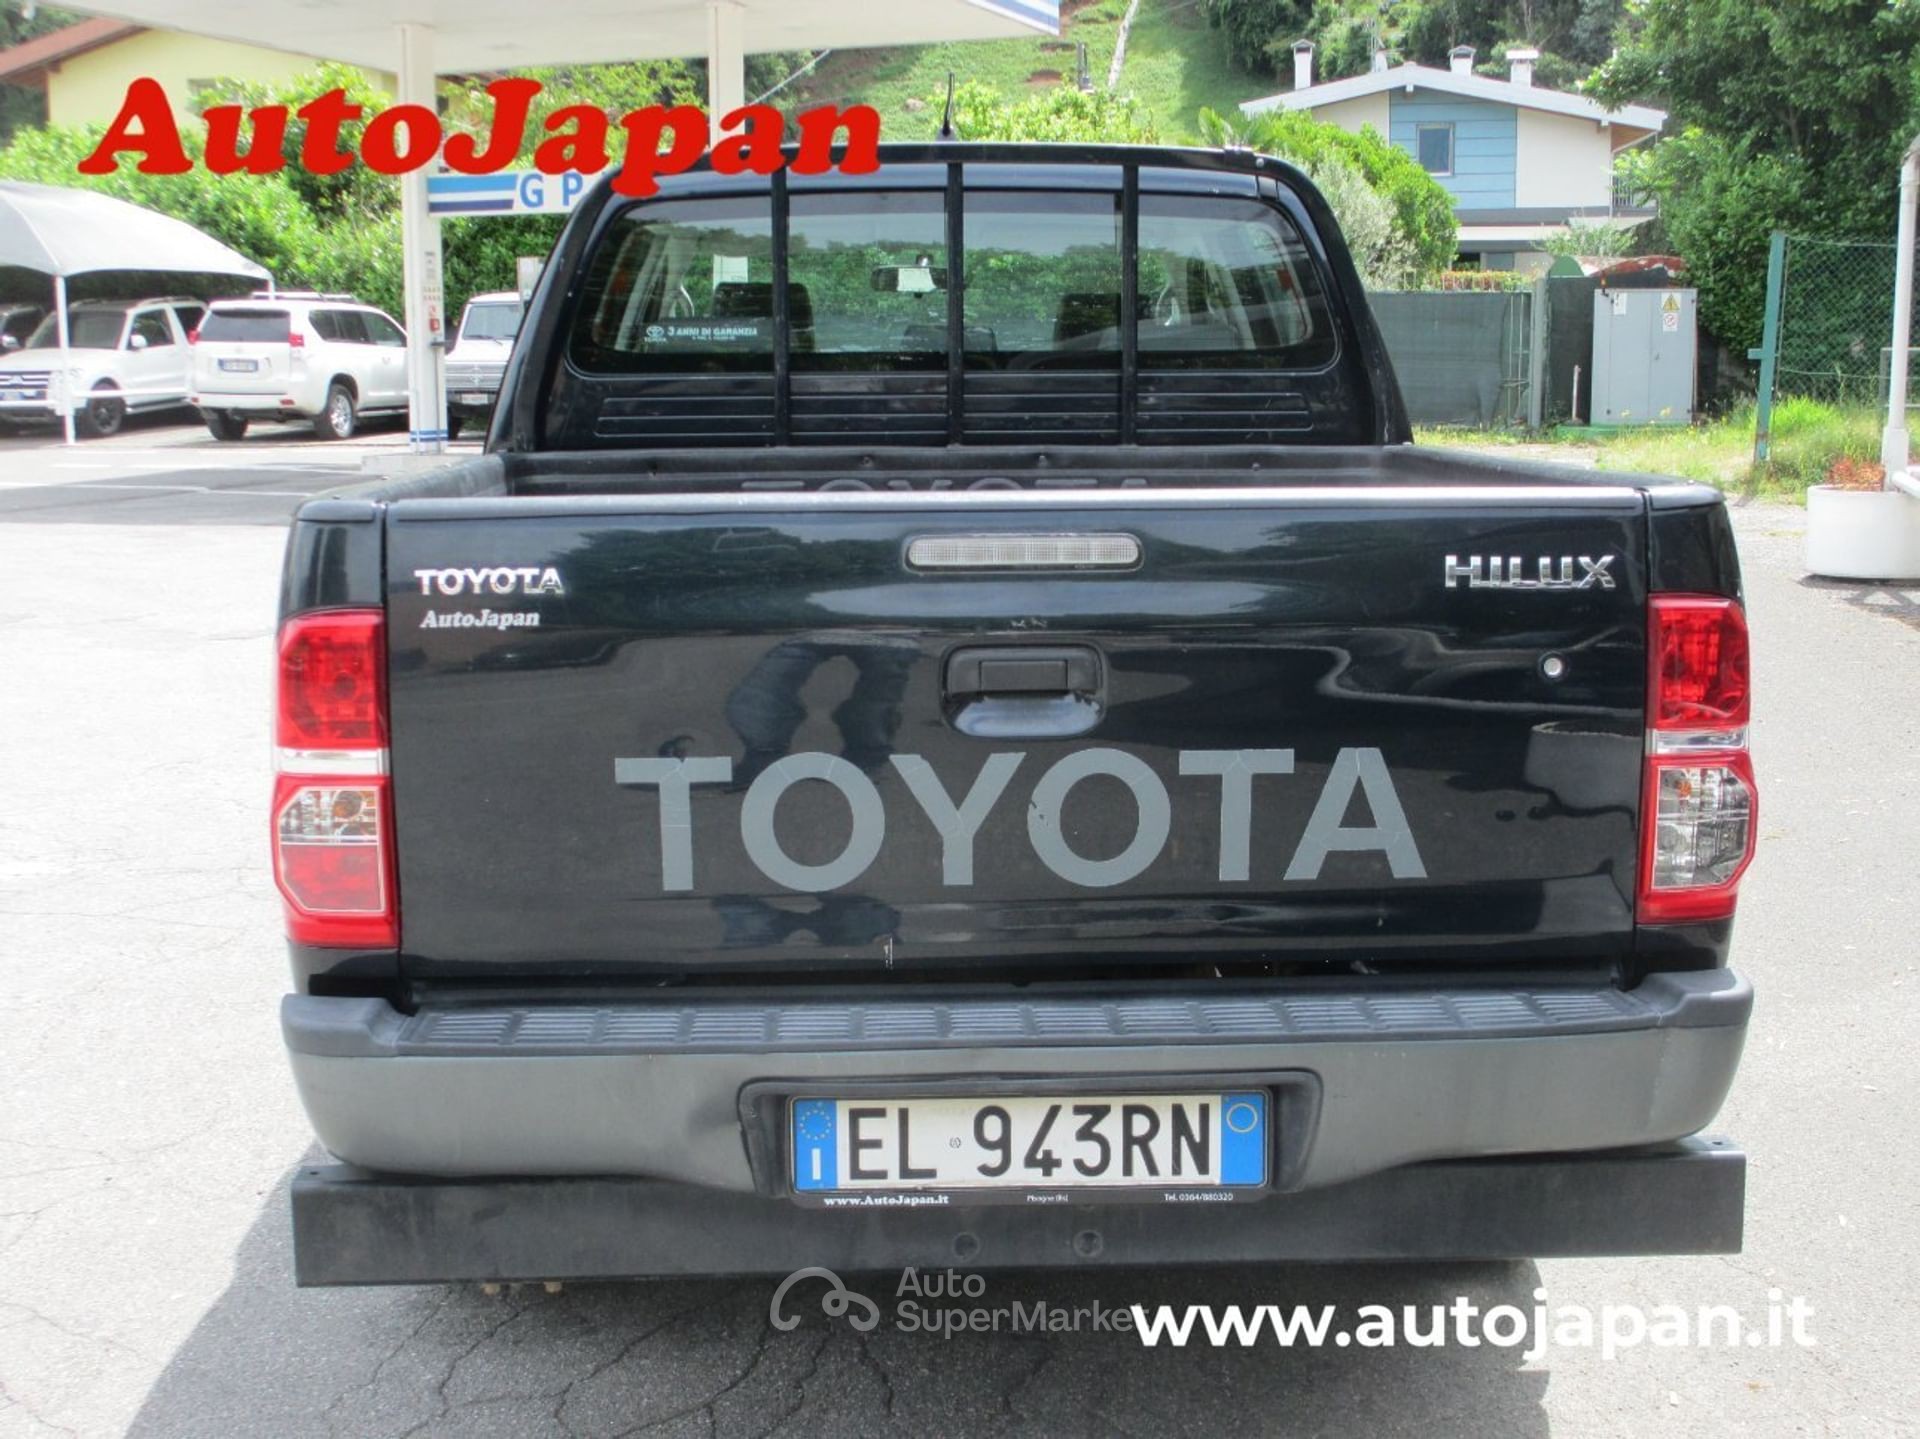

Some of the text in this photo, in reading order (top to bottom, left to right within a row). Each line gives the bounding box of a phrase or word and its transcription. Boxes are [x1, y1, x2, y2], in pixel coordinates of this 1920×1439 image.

[701, 327, 711, 336] DI
[414, 567, 564, 596] TOYOTA
[1445, 555, 1617, 590] HILUX
[419, 608, 541, 631] AutoJapan
[614, 746, 1428, 892] TOYOTA
[824, 1194, 949, 1207] www.AutoJapan.it
